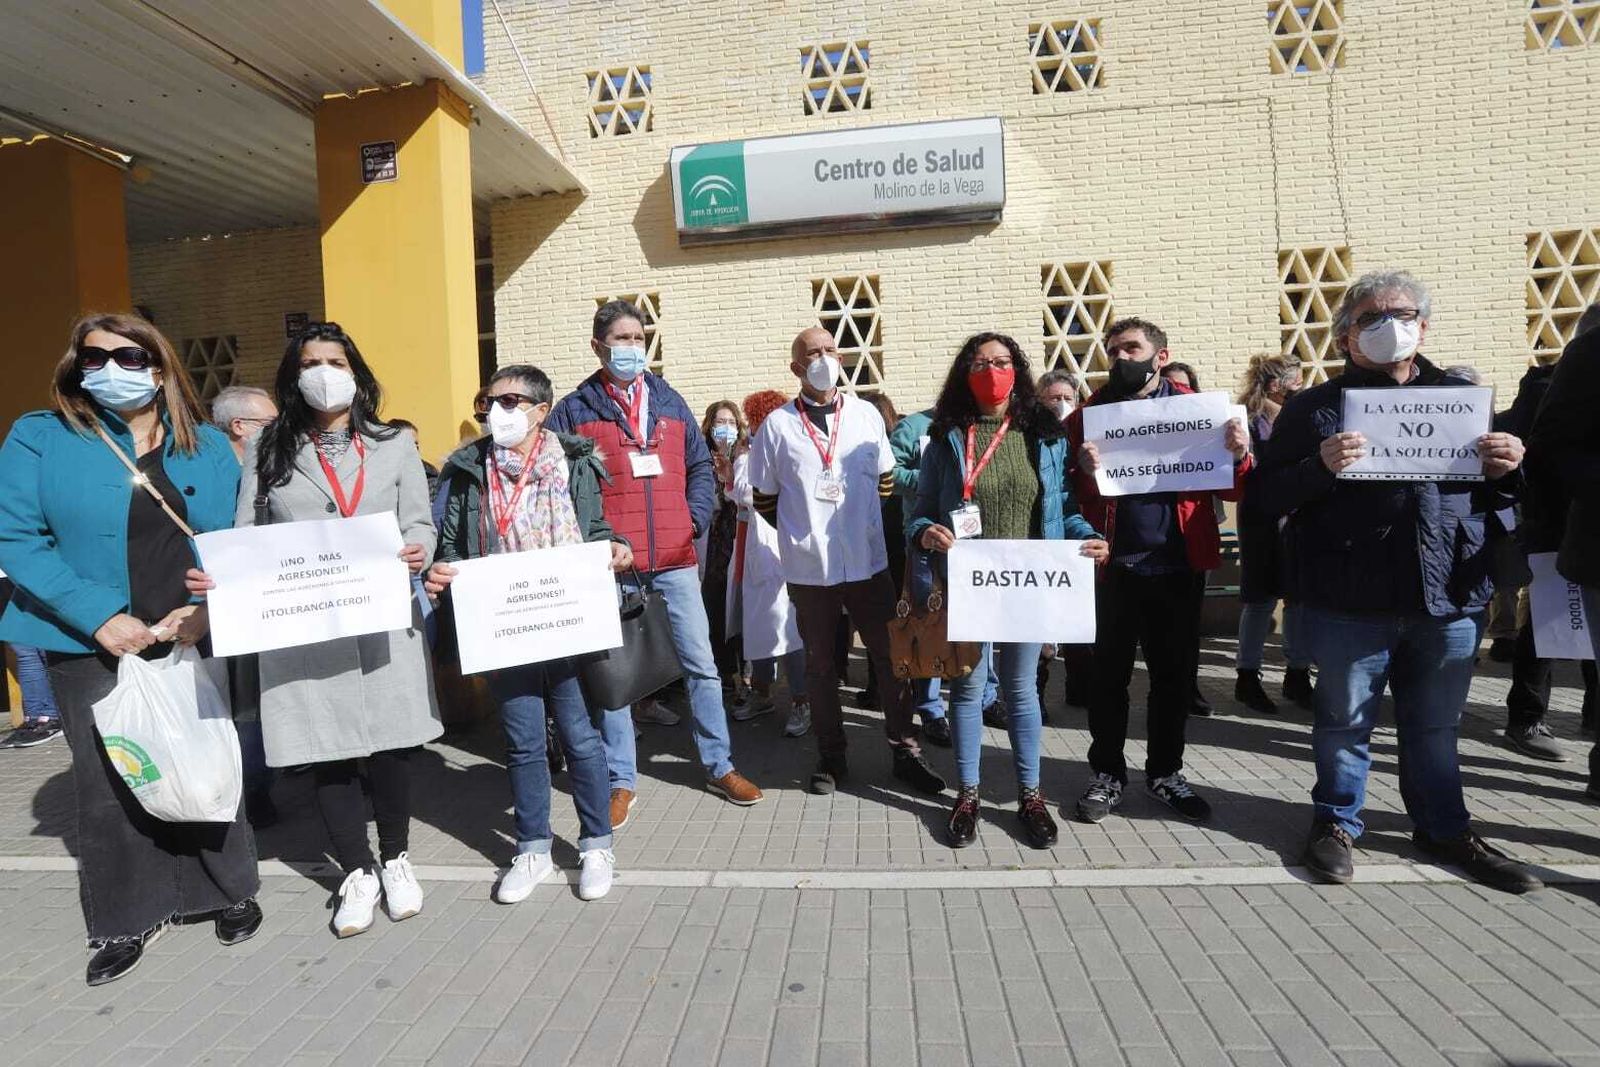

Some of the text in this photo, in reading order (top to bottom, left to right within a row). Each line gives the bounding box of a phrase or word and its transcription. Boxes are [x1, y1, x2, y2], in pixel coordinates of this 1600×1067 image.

[814, 147, 984, 182] Centro de Salud
[874, 177, 984, 200] Molino de la Vega
[1364, 400, 1474, 414] LA AGRESIÓN
[1105, 418, 1212, 440] NO AGRESIONES
[1397, 422, 1434, 438] NO
[1371, 446, 1390, 457] LA
[1106, 461, 1214, 478] MÁS SEGURIDAD
[277, 565, 349, 582] AGRESIONES!!
[972, 570, 1072, 587] BASTA YA
[506, 589, 565, 604] AGRESIONES!!
[261, 595, 371, 620] ¡¡TOLERANCIA CERO!!
[1568, 597, 1583, 631] TODOS
[494, 617, 584, 638] ¡¡TOLERANCIA CERO!!
